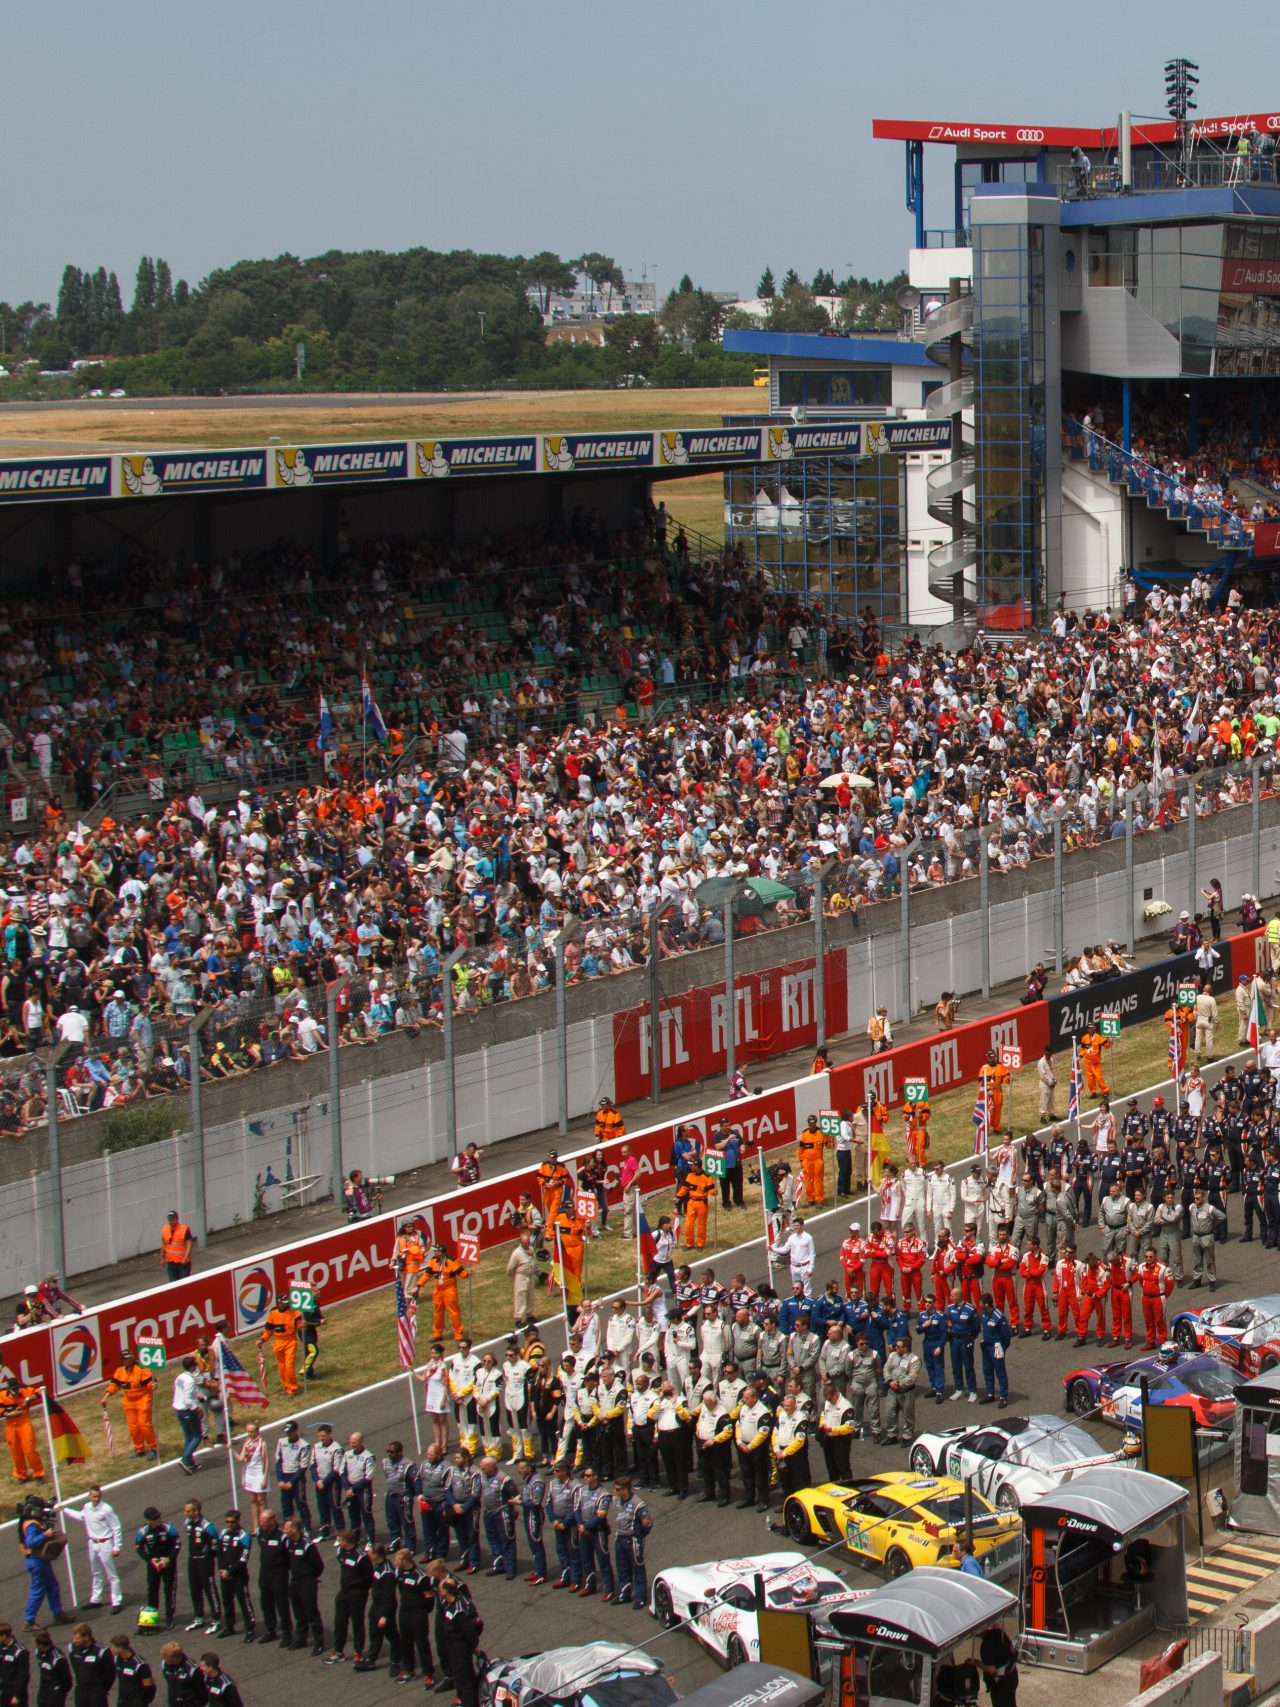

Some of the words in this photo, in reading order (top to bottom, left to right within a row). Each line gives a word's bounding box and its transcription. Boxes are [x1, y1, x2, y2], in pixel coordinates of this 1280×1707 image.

[944, 127, 972, 139] Audi
[973, 128, 1006, 141] Sport
[1190, 123, 1218, 135] Audi
[1220, 119, 1256, 133] Sport
[1244, 270, 1265, 283] Audi
[795, 431, 859, 449] MICHELIN
[891, 426, 950, 444] MICHELIN
[575, 441, 652, 458] MICHELIN
[689, 436, 760, 454] MICHELIN
[313, 451, 405, 473] MICHELIN
[450, 444, 534, 465] MICHELIN
[163, 459, 263, 481] MICHELIN
[1179, 990, 1196, 1003] 99
[711, 986, 758, 1054] RTL
[1060, 1001, 1084, 1036] 24h
[1103, 994, 1138, 1016] MANS
[1102, 1020, 1118, 1034] 51
[930, 1039, 963, 1088] RTL
[1002, 1053, 1021, 1068] 98
[906, 1085, 926, 1100] 97
[820, 1118, 840, 1134] 95
[706, 1149, 724, 1158] MOTUL
[706, 1158, 724, 1176] 91
[577, 1190, 596, 1199] MOTUL
[577, 1200, 596, 1218] 83
[443, 1199, 518, 1244] TOTA
[458, 1233, 479, 1242] MOTUL
[459, 1243, 479, 1262] 72
[286, 1244, 390, 1290] TOTAL
[290, 1280, 312, 1289] MOTUL
[290, 1290, 312, 1310] 92
[110, 1299, 226, 1352] TOTAL
[138, 1336, 163, 1345] MOTUL
[138, 1347, 164, 1368] 64
[950, 1458, 961, 1478] 92
[907, 1533, 923, 1545] Mobil
